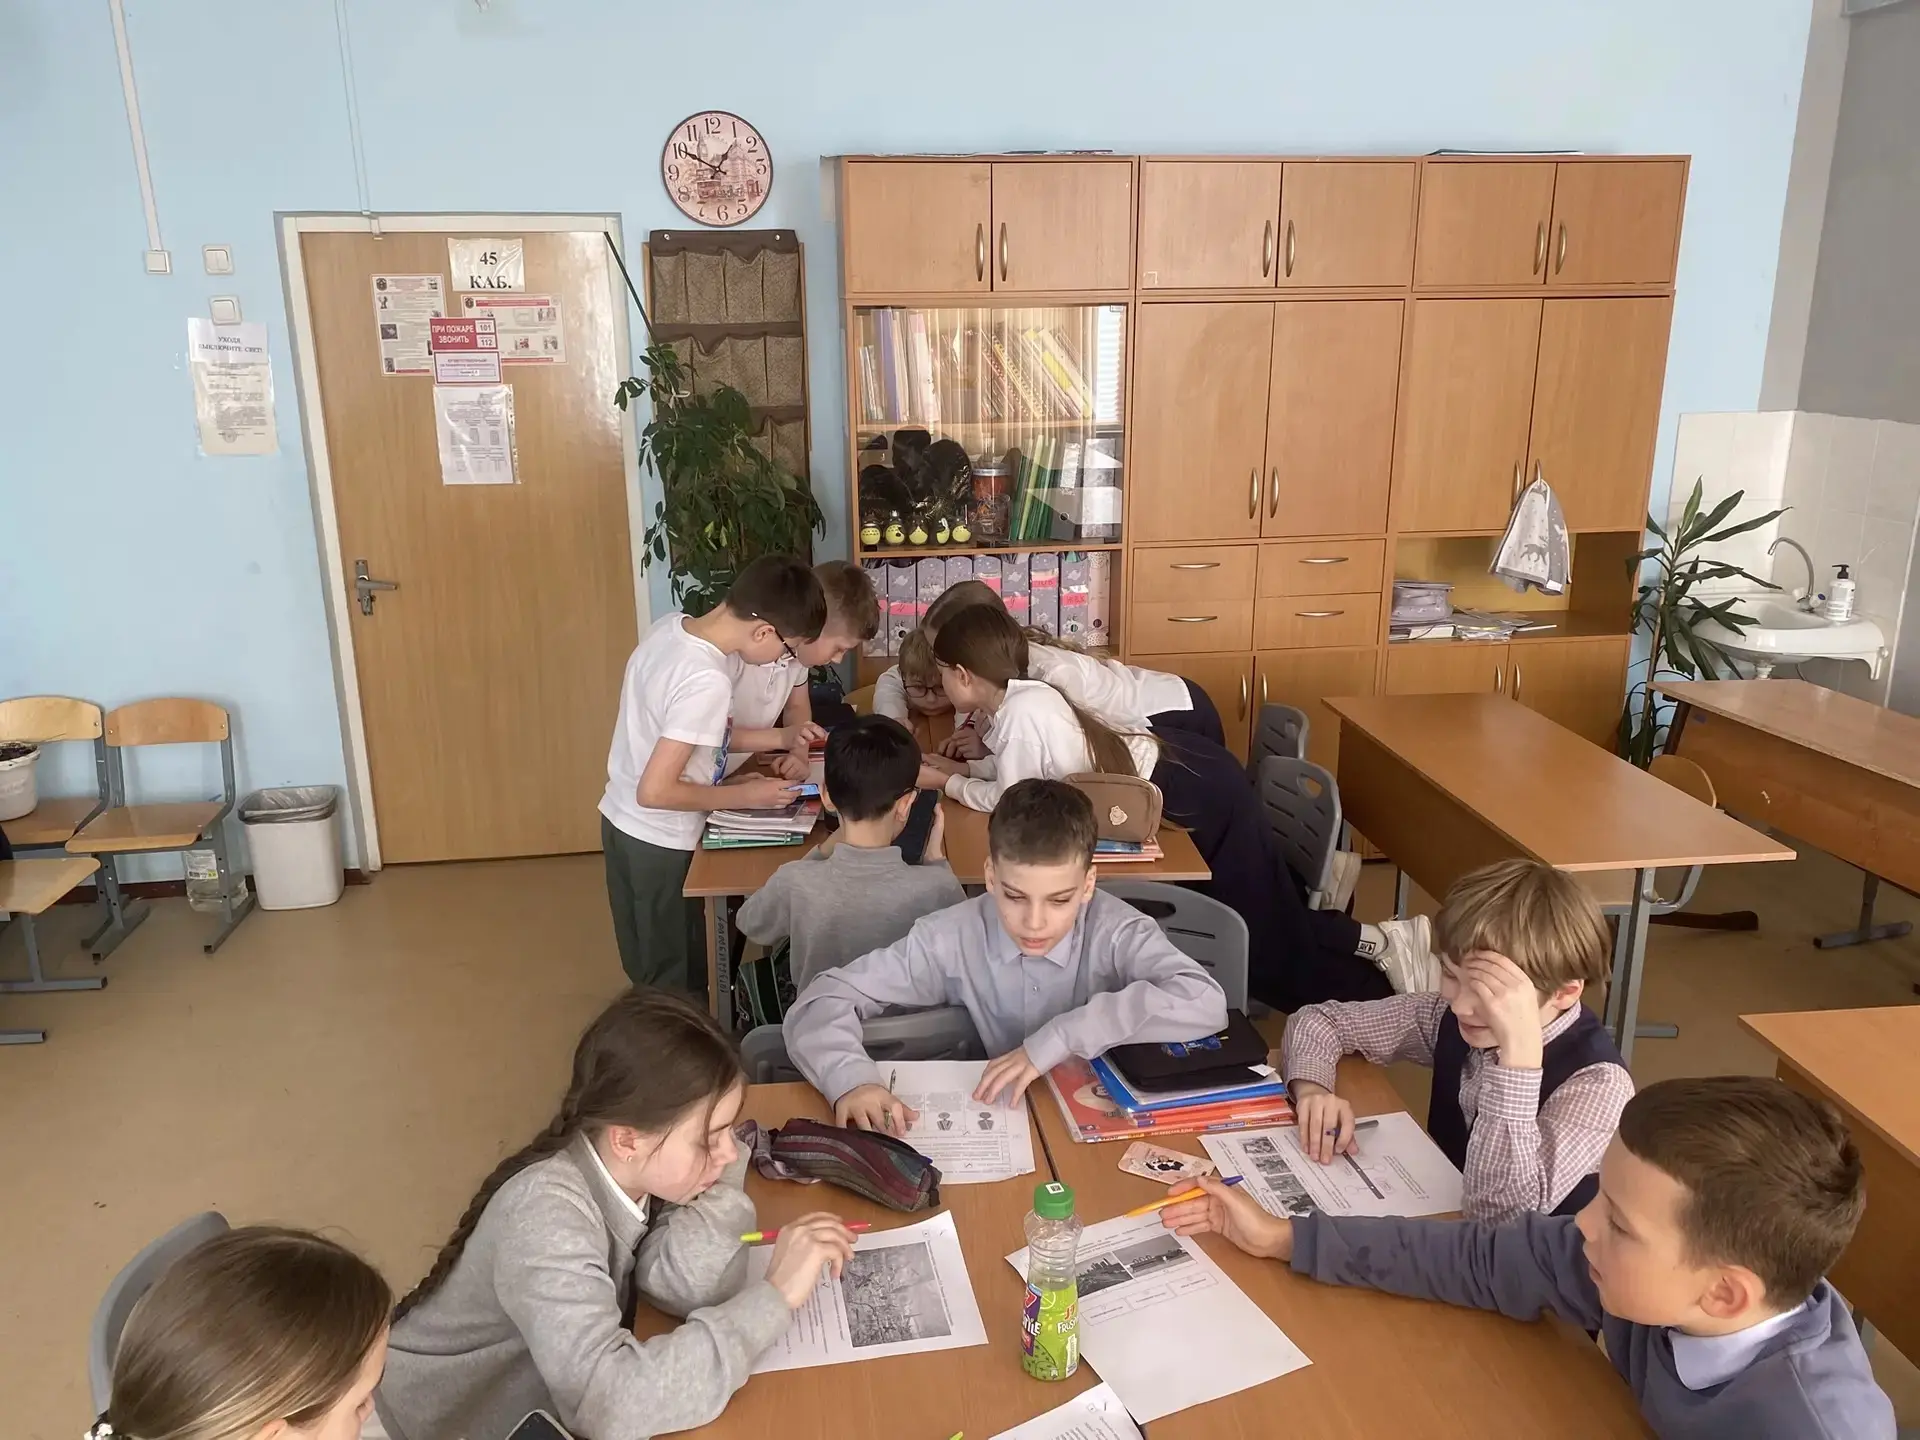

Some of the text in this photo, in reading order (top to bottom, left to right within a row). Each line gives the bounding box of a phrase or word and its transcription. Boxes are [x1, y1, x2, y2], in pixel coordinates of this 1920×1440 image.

[686, 124, 698, 141] 11
[705, 117, 721, 134] 12
[731, 121, 737, 138] 1
[673, 142, 688, 159] 10
[746, 136, 758, 153] 2
[668, 164, 680, 181] 9
[756, 158, 767, 175] 3
[678, 186, 690, 202] 8
[697, 201, 706, 217] 7
[717, 205, 729, 221] 6
[737, 198, 748, 215] 5
[479, 251, 498, 265] 45
[469, 275, 512, 289] КАБ.
[432, 325, 474, 333] ПРИ ПОЖАРЕ
[438, 335, 470, 343] ЗВОНИТЬ
